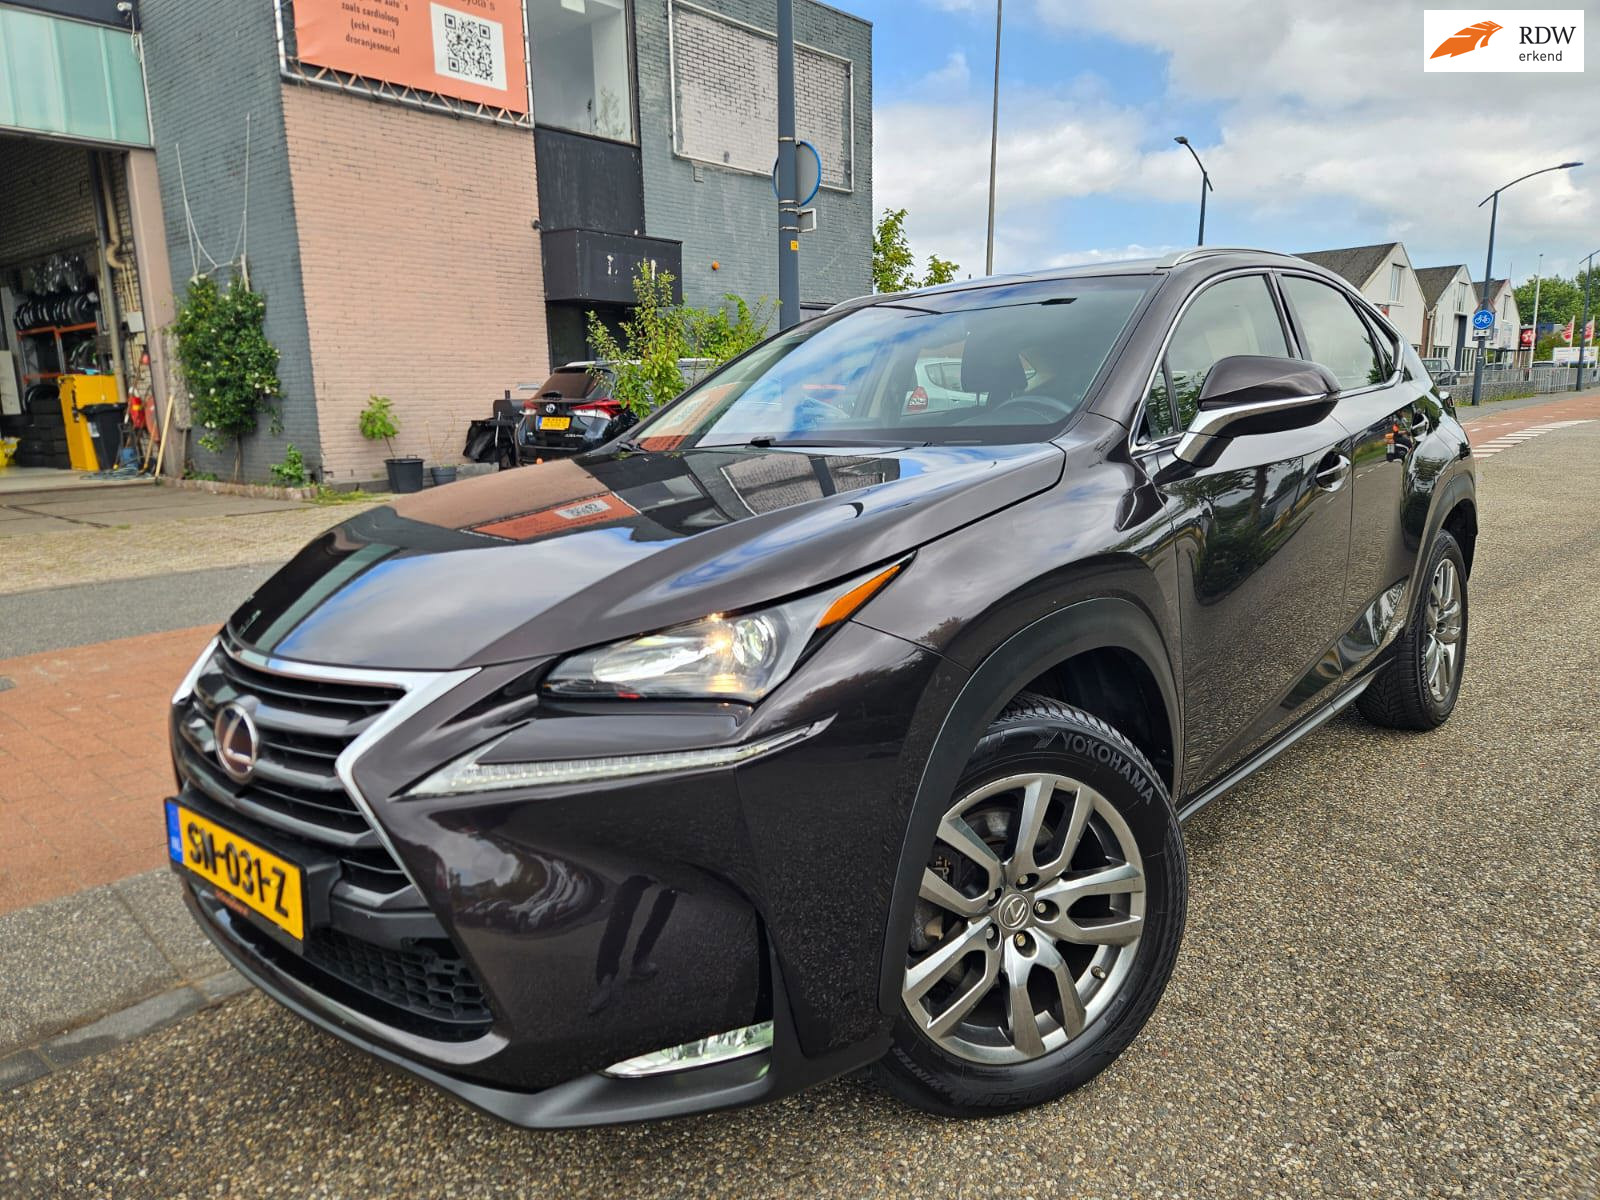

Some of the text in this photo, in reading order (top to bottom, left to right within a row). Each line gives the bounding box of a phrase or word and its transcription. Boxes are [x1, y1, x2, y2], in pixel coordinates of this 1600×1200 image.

[341, 2, 360, 14] zoals
[1060, 730, 1155, 805] YOKOHAMA
[187, 821, 289, 919] SN-031-Z
